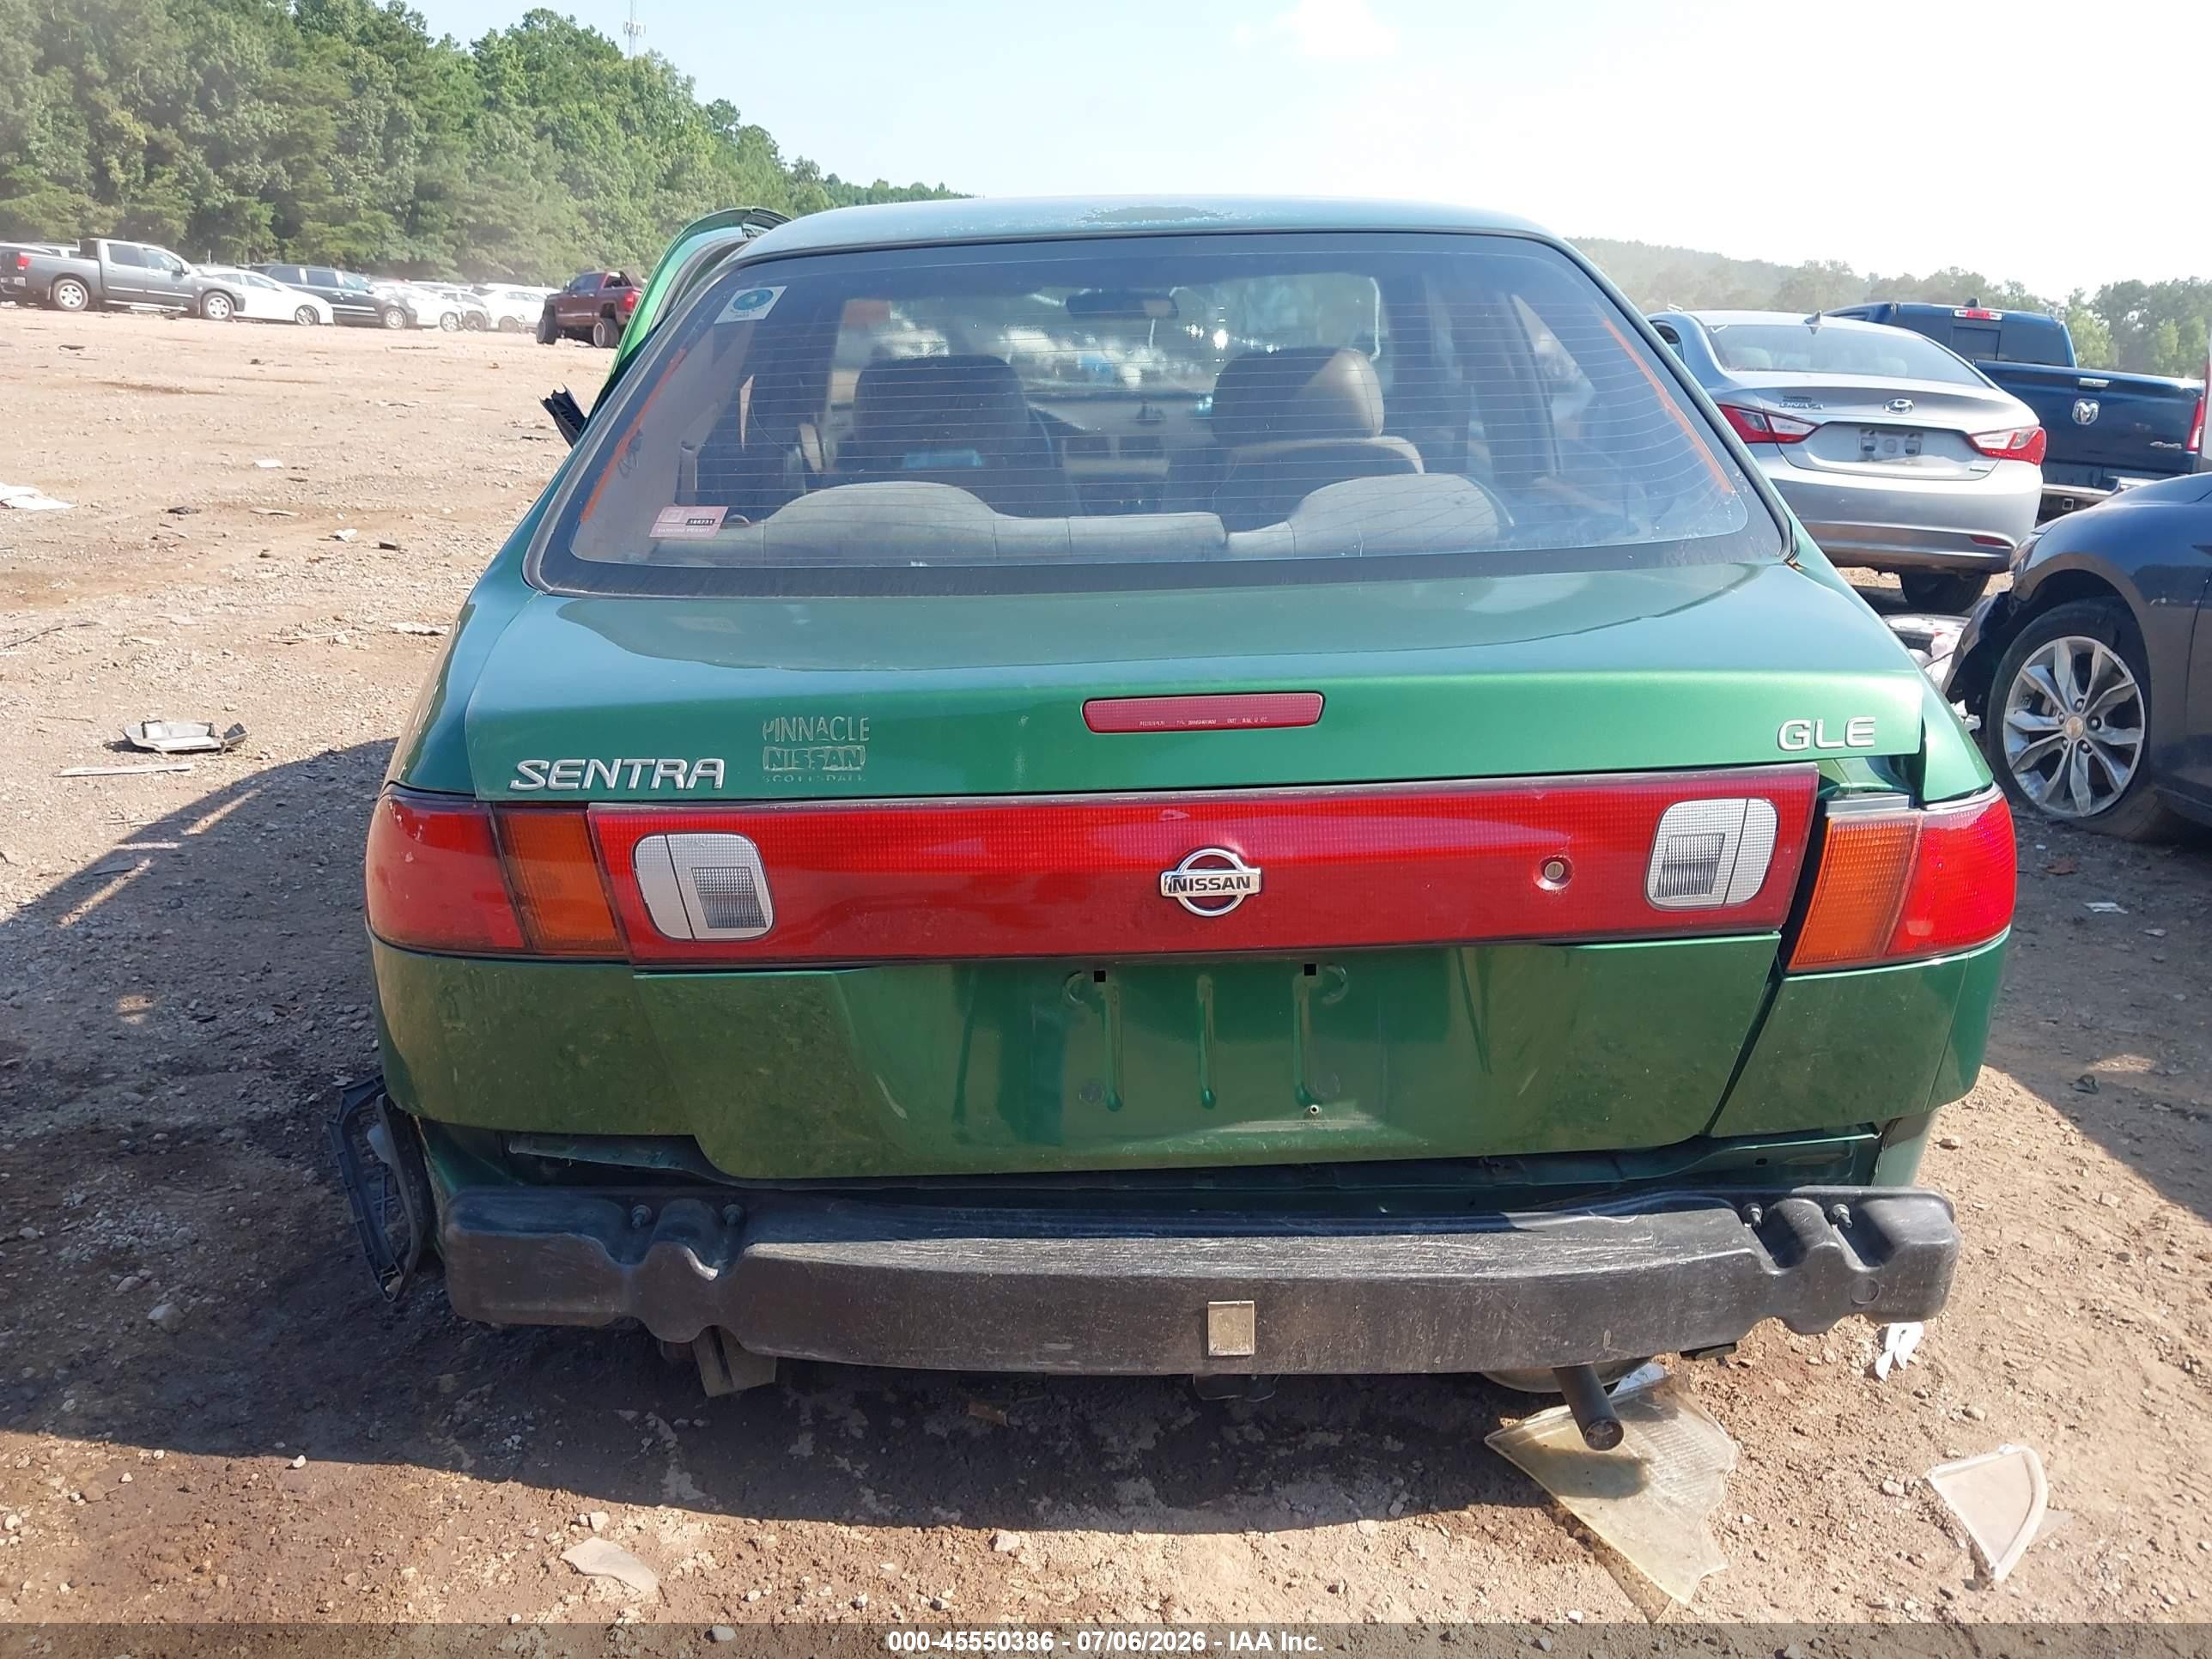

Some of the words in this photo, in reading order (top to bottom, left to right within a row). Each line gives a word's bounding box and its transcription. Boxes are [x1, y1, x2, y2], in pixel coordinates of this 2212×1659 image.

[763, 716, 870, 742] PINNACLE
[1778, 716, 1876, 751] GLE
[509, 758, 725, 791] SENTRA
[1169, 876, 1250, 892] NISSAN
